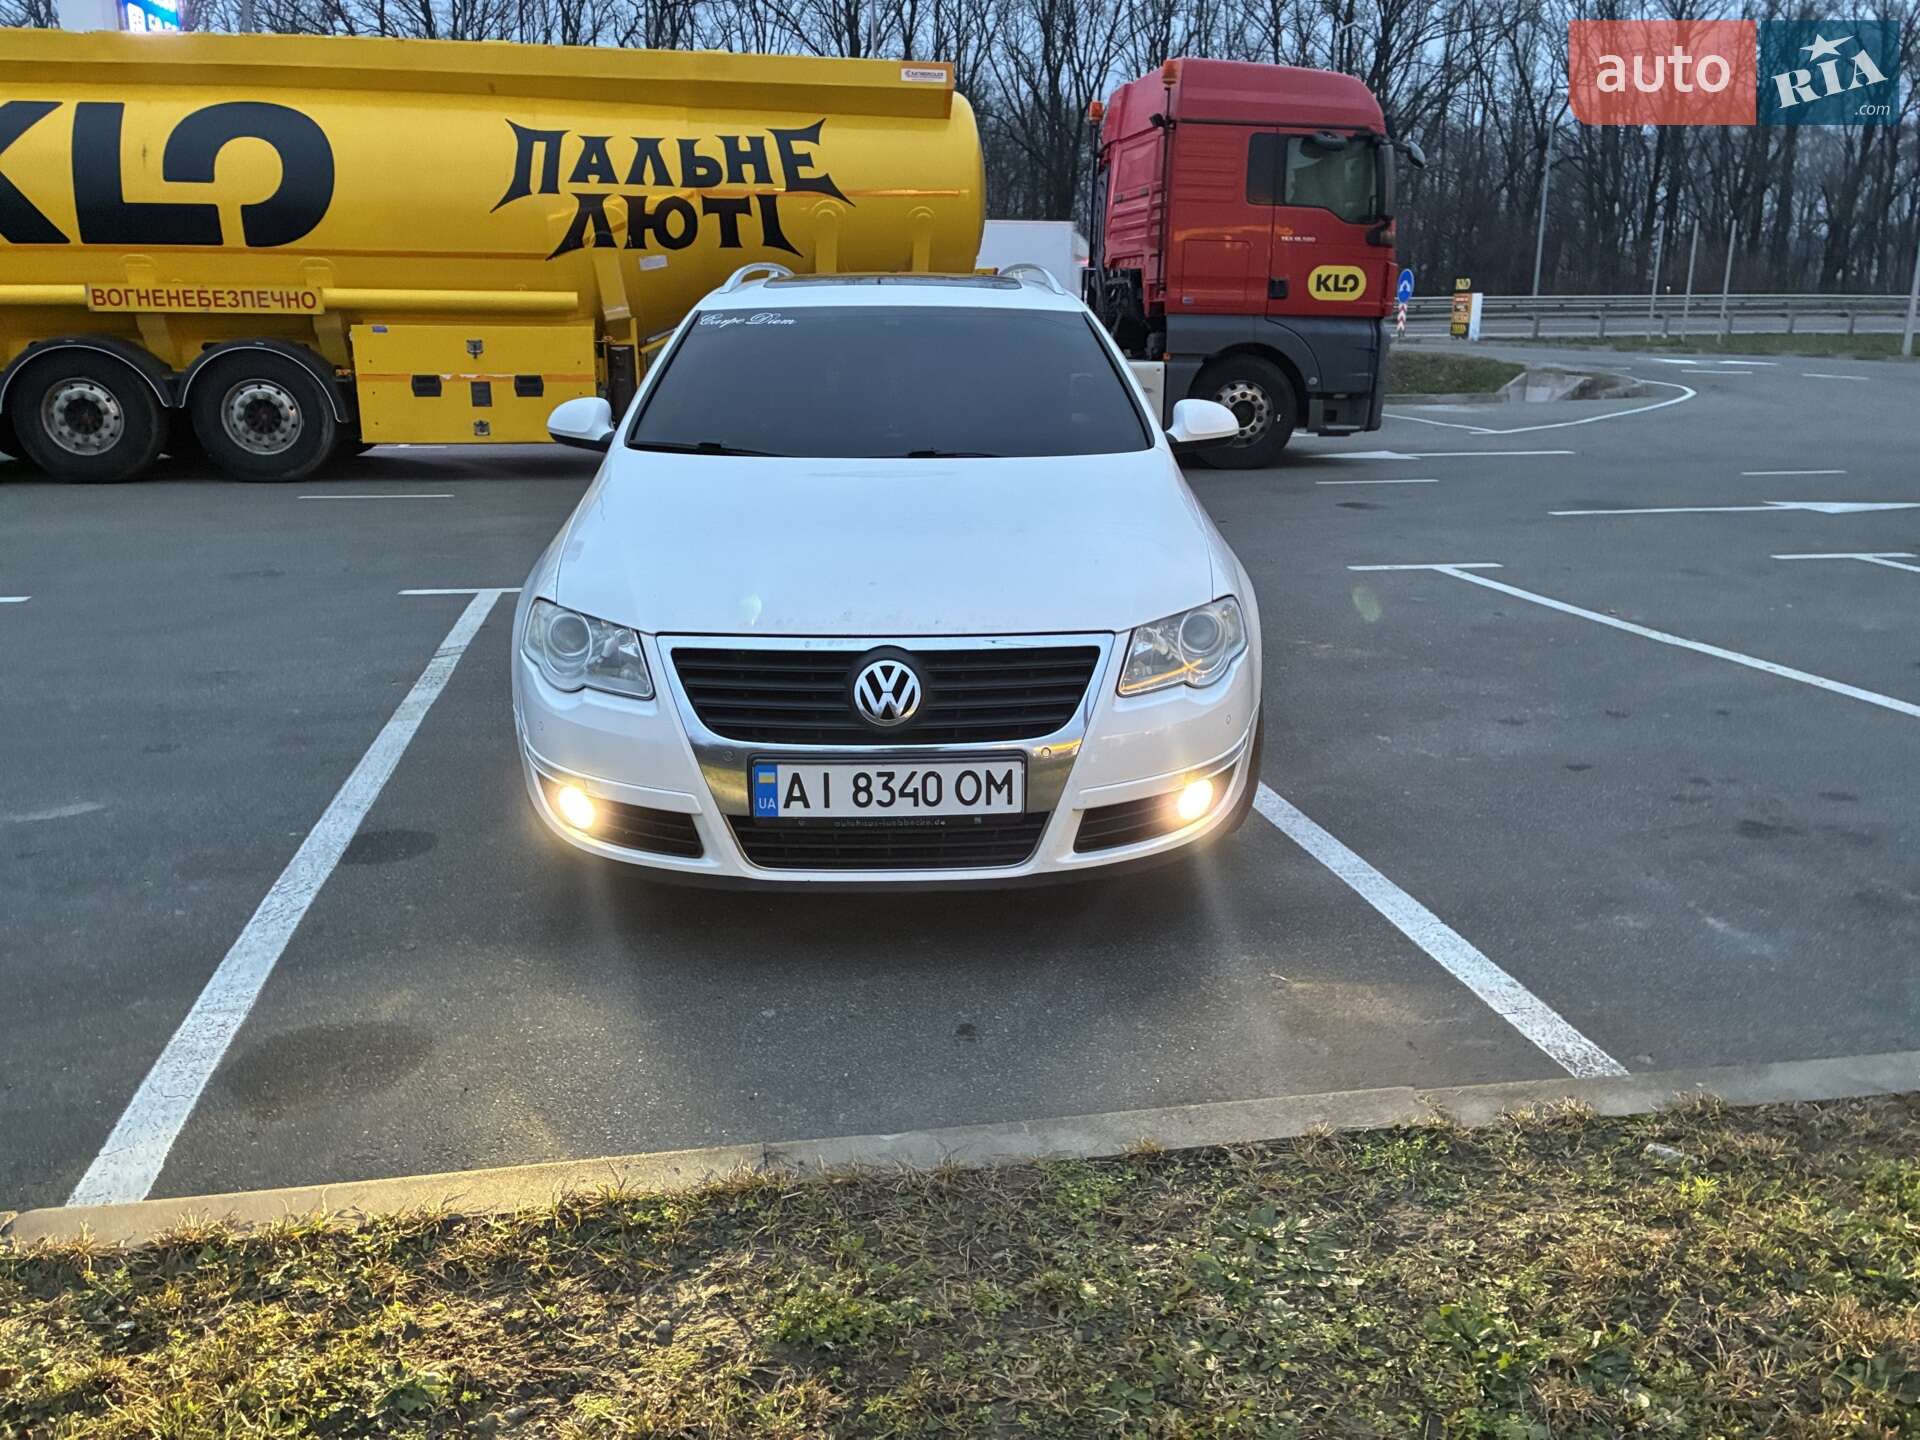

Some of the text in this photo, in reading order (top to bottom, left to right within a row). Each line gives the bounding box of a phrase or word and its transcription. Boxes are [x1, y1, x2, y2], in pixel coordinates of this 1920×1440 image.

[490, 117, 856, 214] ПАЛЬНЕ
[545, 192, 804, 262] ЛЮТІ
[91, 287, 317, 310] ВОГНЕНЕБЕЗПЕЧНО
[1315, 273, 1360, 293] KLO
[758, 798, 777, 810] UA
[851, 770, 943, 809] 8340
[954, 768, 1014, 807] OM
